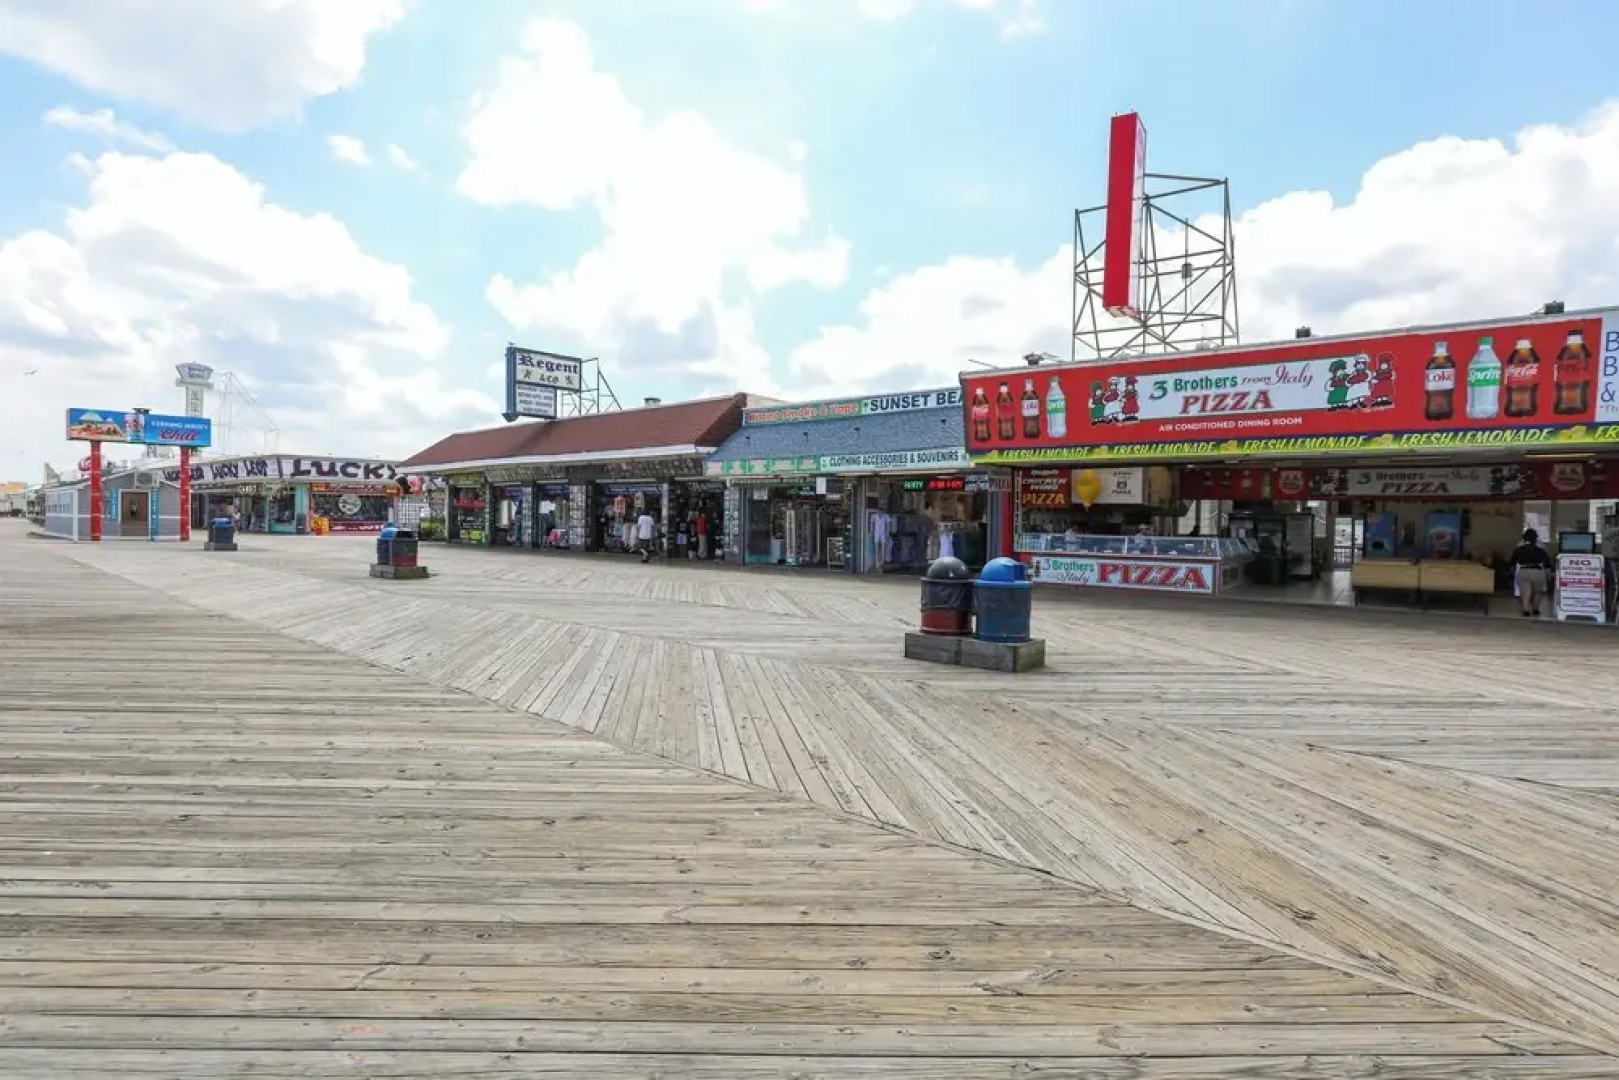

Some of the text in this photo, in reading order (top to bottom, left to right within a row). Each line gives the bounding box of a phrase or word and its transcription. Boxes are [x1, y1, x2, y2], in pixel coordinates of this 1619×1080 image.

[518, 354, 579, 374] Regent
[1148, 380, 1168, 400] 3
[1173, 376, 1238, 392] Brothers
[1271, 362, 1313, 388] Italy
[870, 394, 932, 412] SUNSET
[1179, 389, 1275, 415] PIZZA
[1159, 417, 1303, 432] AIR CONDITIONED DINING ROOM
[1243, 435, 1368, 451] FRESH LEMONADE
[1400, 428, 1553, 447] FRESH LEMONADE
[1113, 442, 1217, 455] FRESH LEMONADE
[829, 457, 861, 467] CLOTHING
[862, 454, 908, 465] ACCESSORIES
[917, 450, 960, 463] SOUVENIRS
[1380, 481, 1450, 493] PIZZA
[1022, 493, 1066, 505] PIZZA
[1041, 558, 1095, 573] 3 Brothers
[1096, 562, 1210, 592] PIZZA
